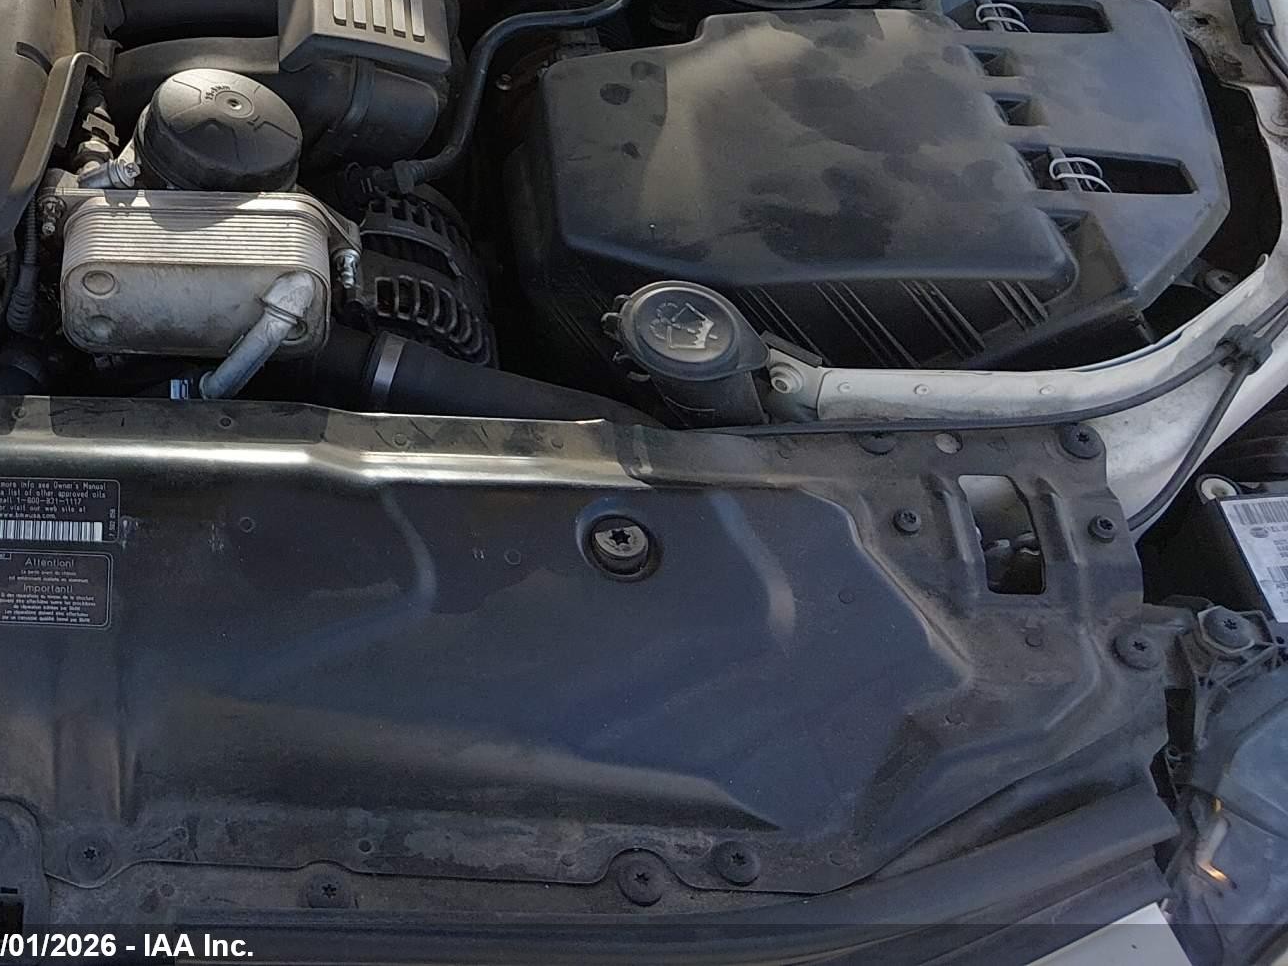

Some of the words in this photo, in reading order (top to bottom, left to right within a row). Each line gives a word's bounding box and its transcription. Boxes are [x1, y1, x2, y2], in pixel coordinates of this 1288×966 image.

[83, 482, 106, 490] Manual
[24, 557, 74, 568] Attention!
[23, 584, 73, 594] Important!
